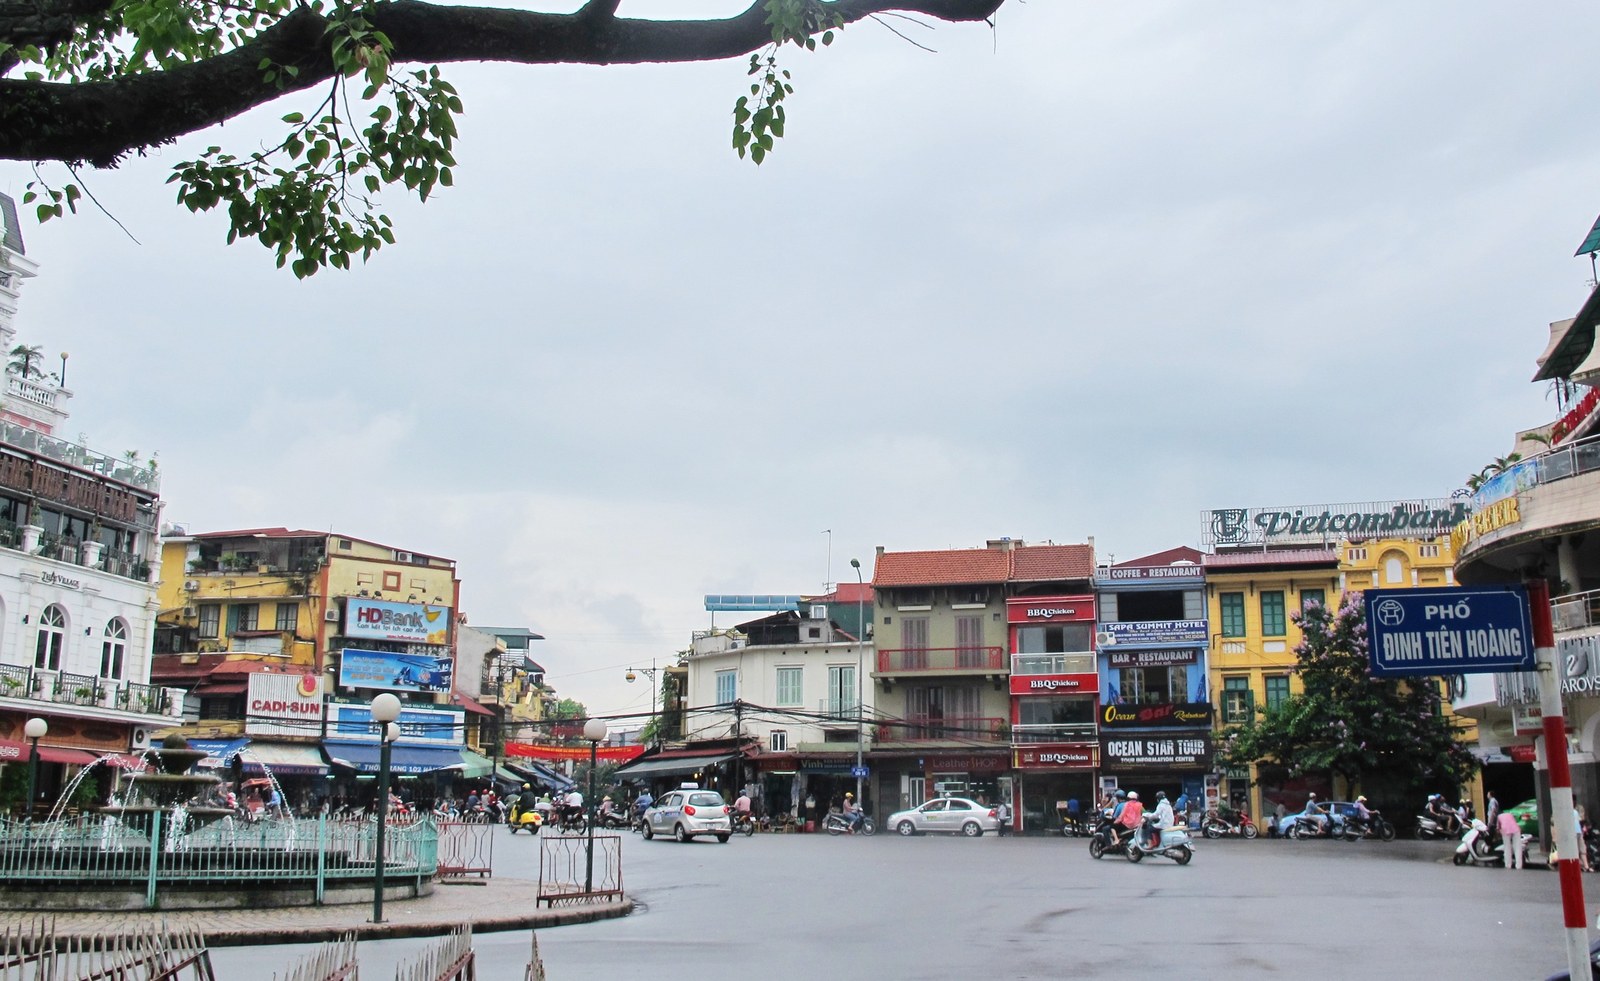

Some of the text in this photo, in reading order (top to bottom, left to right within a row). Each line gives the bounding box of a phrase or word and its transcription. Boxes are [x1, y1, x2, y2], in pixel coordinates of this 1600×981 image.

[1254, 502, 1473, 536] Vietcombank
[1473, 497, 1521, 538] BEER
[1111, 567, 1201, 578] COFFEE RESTAURANT
[1027, 608, 1052, 618] BBQ
[1424, 597, 1471, 620] PHỐ
[357, 606, 424, 628] HDBank
[1136, 622, 1172, 630] SUMMIT
[1382, 623, 1522, 661] ĐINH TIÊN HOÀNG
[1112, 650, 1193, 664] BAR RESTAURANT
[1030, 679, 1056, 690] BBQ
[1104, 705, 1136, 723] Ocean
[1107, 739, 1205, 757] OCEAN STAR TOUR
[933, 758, 970, 768] Leather
[1040, 753, 1066, 764] BBQ
